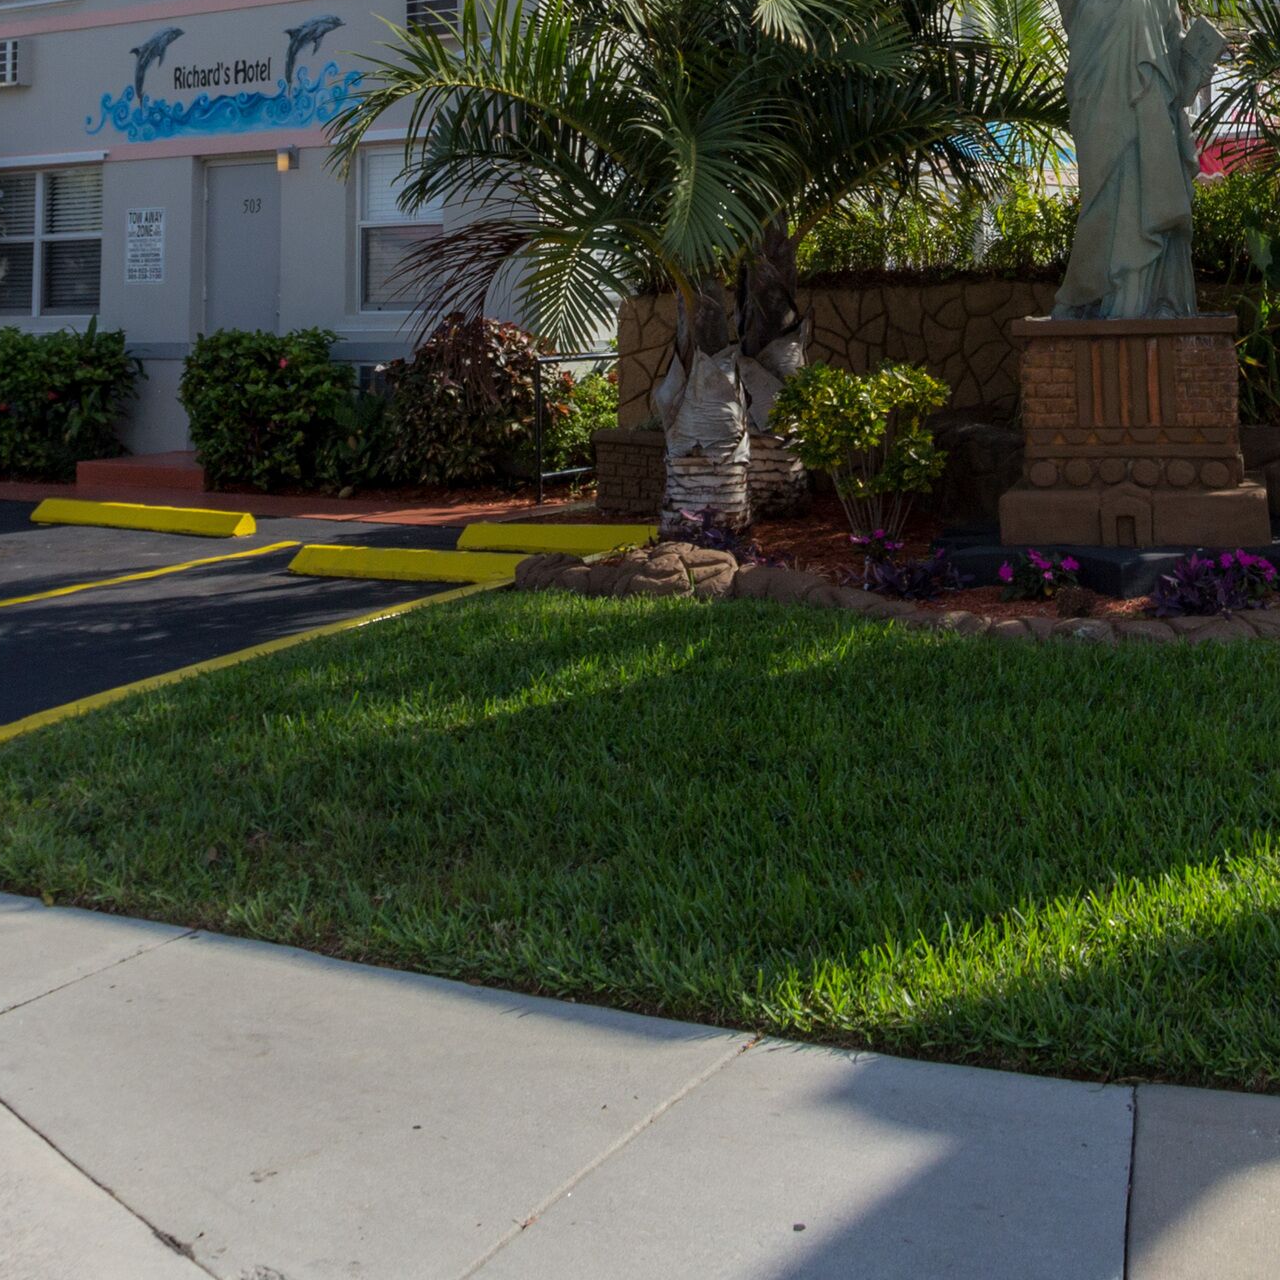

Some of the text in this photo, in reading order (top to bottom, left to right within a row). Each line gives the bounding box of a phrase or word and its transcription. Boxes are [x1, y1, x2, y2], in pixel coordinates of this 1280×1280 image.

[173, 56, 272, 90] Richard's Hotel
[242, 197, 262, 215] 503
[136, 224, 153, 238] ZONE
